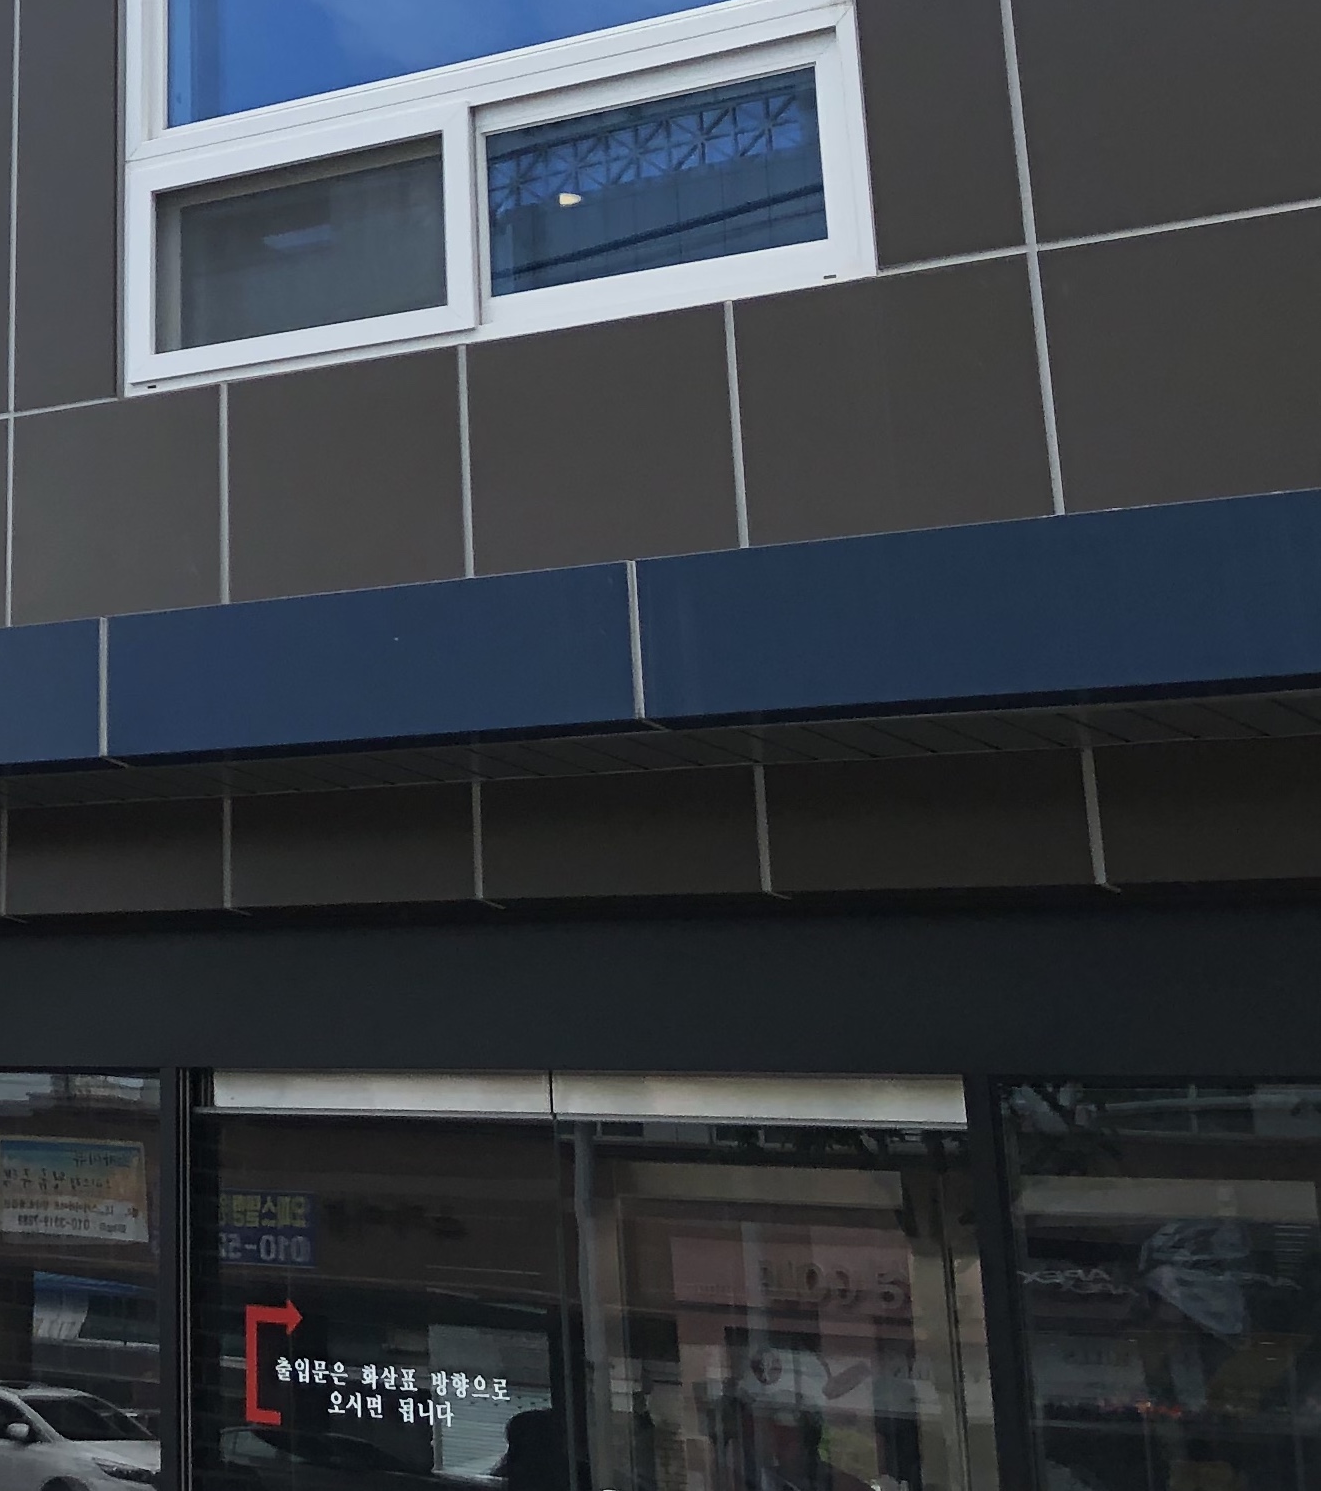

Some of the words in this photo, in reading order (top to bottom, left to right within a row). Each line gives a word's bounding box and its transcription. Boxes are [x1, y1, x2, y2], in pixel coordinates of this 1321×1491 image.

[275, 1356, 348, 1386] 출입문은
[361, 1363, 418, 1392] 화살표
[431, 1370, 511, 1401] 방향으로
[327, 1390, 383, 1419] 오시면
[398, 1397, 455, 1428] 됩니다
